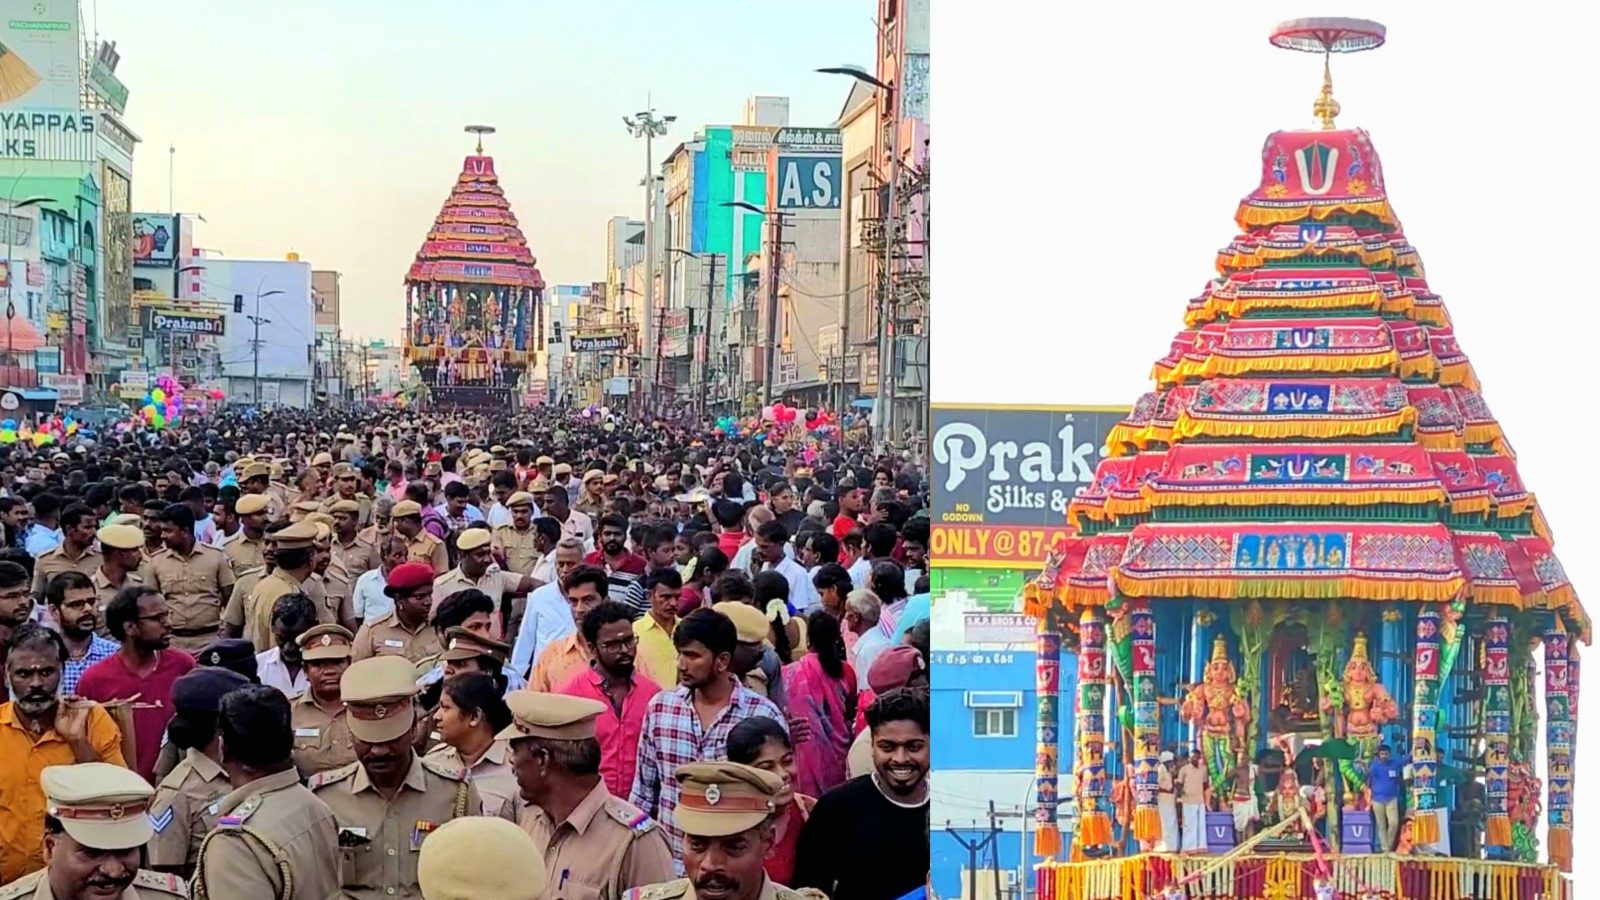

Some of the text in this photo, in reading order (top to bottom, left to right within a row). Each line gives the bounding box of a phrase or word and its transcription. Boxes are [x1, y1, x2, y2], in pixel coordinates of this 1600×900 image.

[0, 113, 94, 132] YAPPAS
[816, 131, 824, 144] &
[0, 139, 35, 156] KS
[781, 162, 839, 207] A.S.
[154, 316, 213, 331] Prakash
[573, 338, 618, 349] Prakash
[933, 422, 1108, 491] Prak
[956, 504, 970, 512] NO
[987, 485, 1068, 515] Silks &
[942, 513, 983, 522] GODOWN
[932, 528, 991, 555] ONLY
[994, 530, 1015, 556] @
